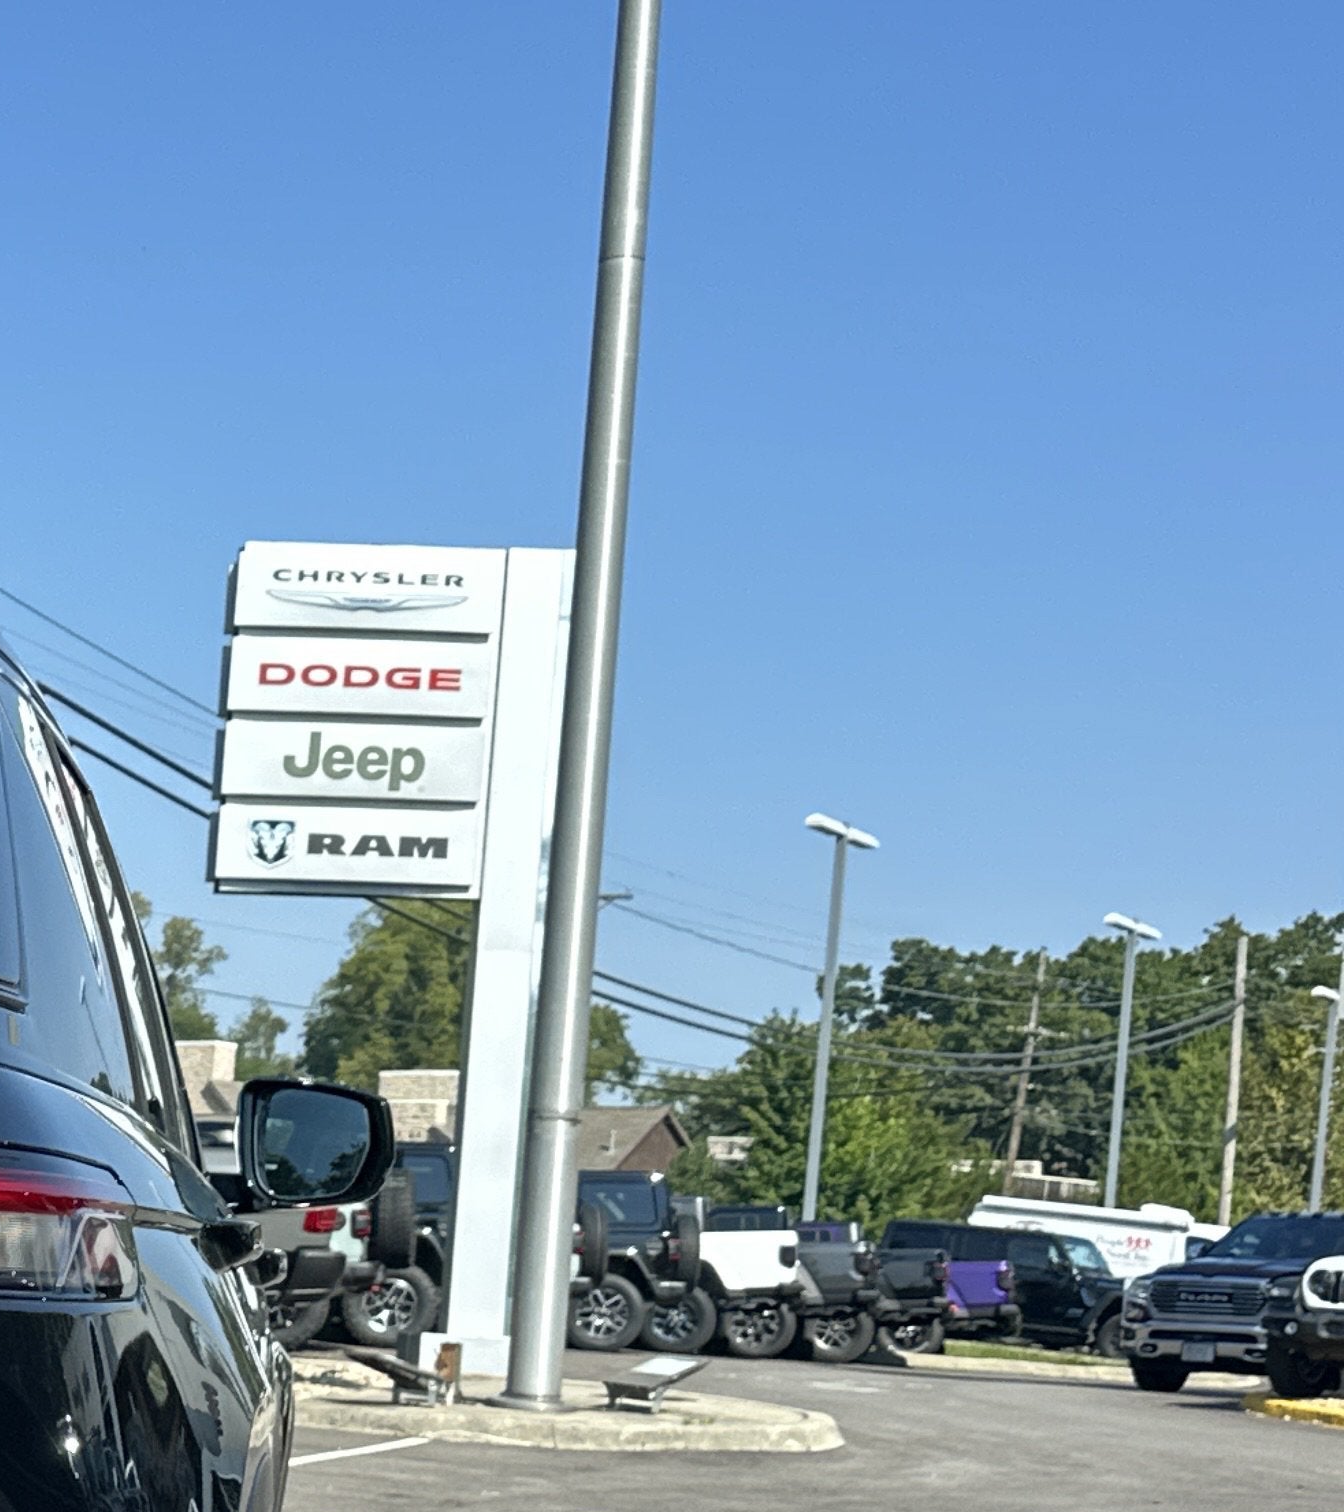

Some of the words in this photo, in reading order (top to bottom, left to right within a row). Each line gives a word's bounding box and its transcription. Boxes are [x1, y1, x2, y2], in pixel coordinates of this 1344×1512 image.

[271, 568, 466, 589] CHRYSLER
[257, 662, 464, 693] DODGE
[282, 731, 426, 792] Jeep
[306, 832, 450, 860] RAM
